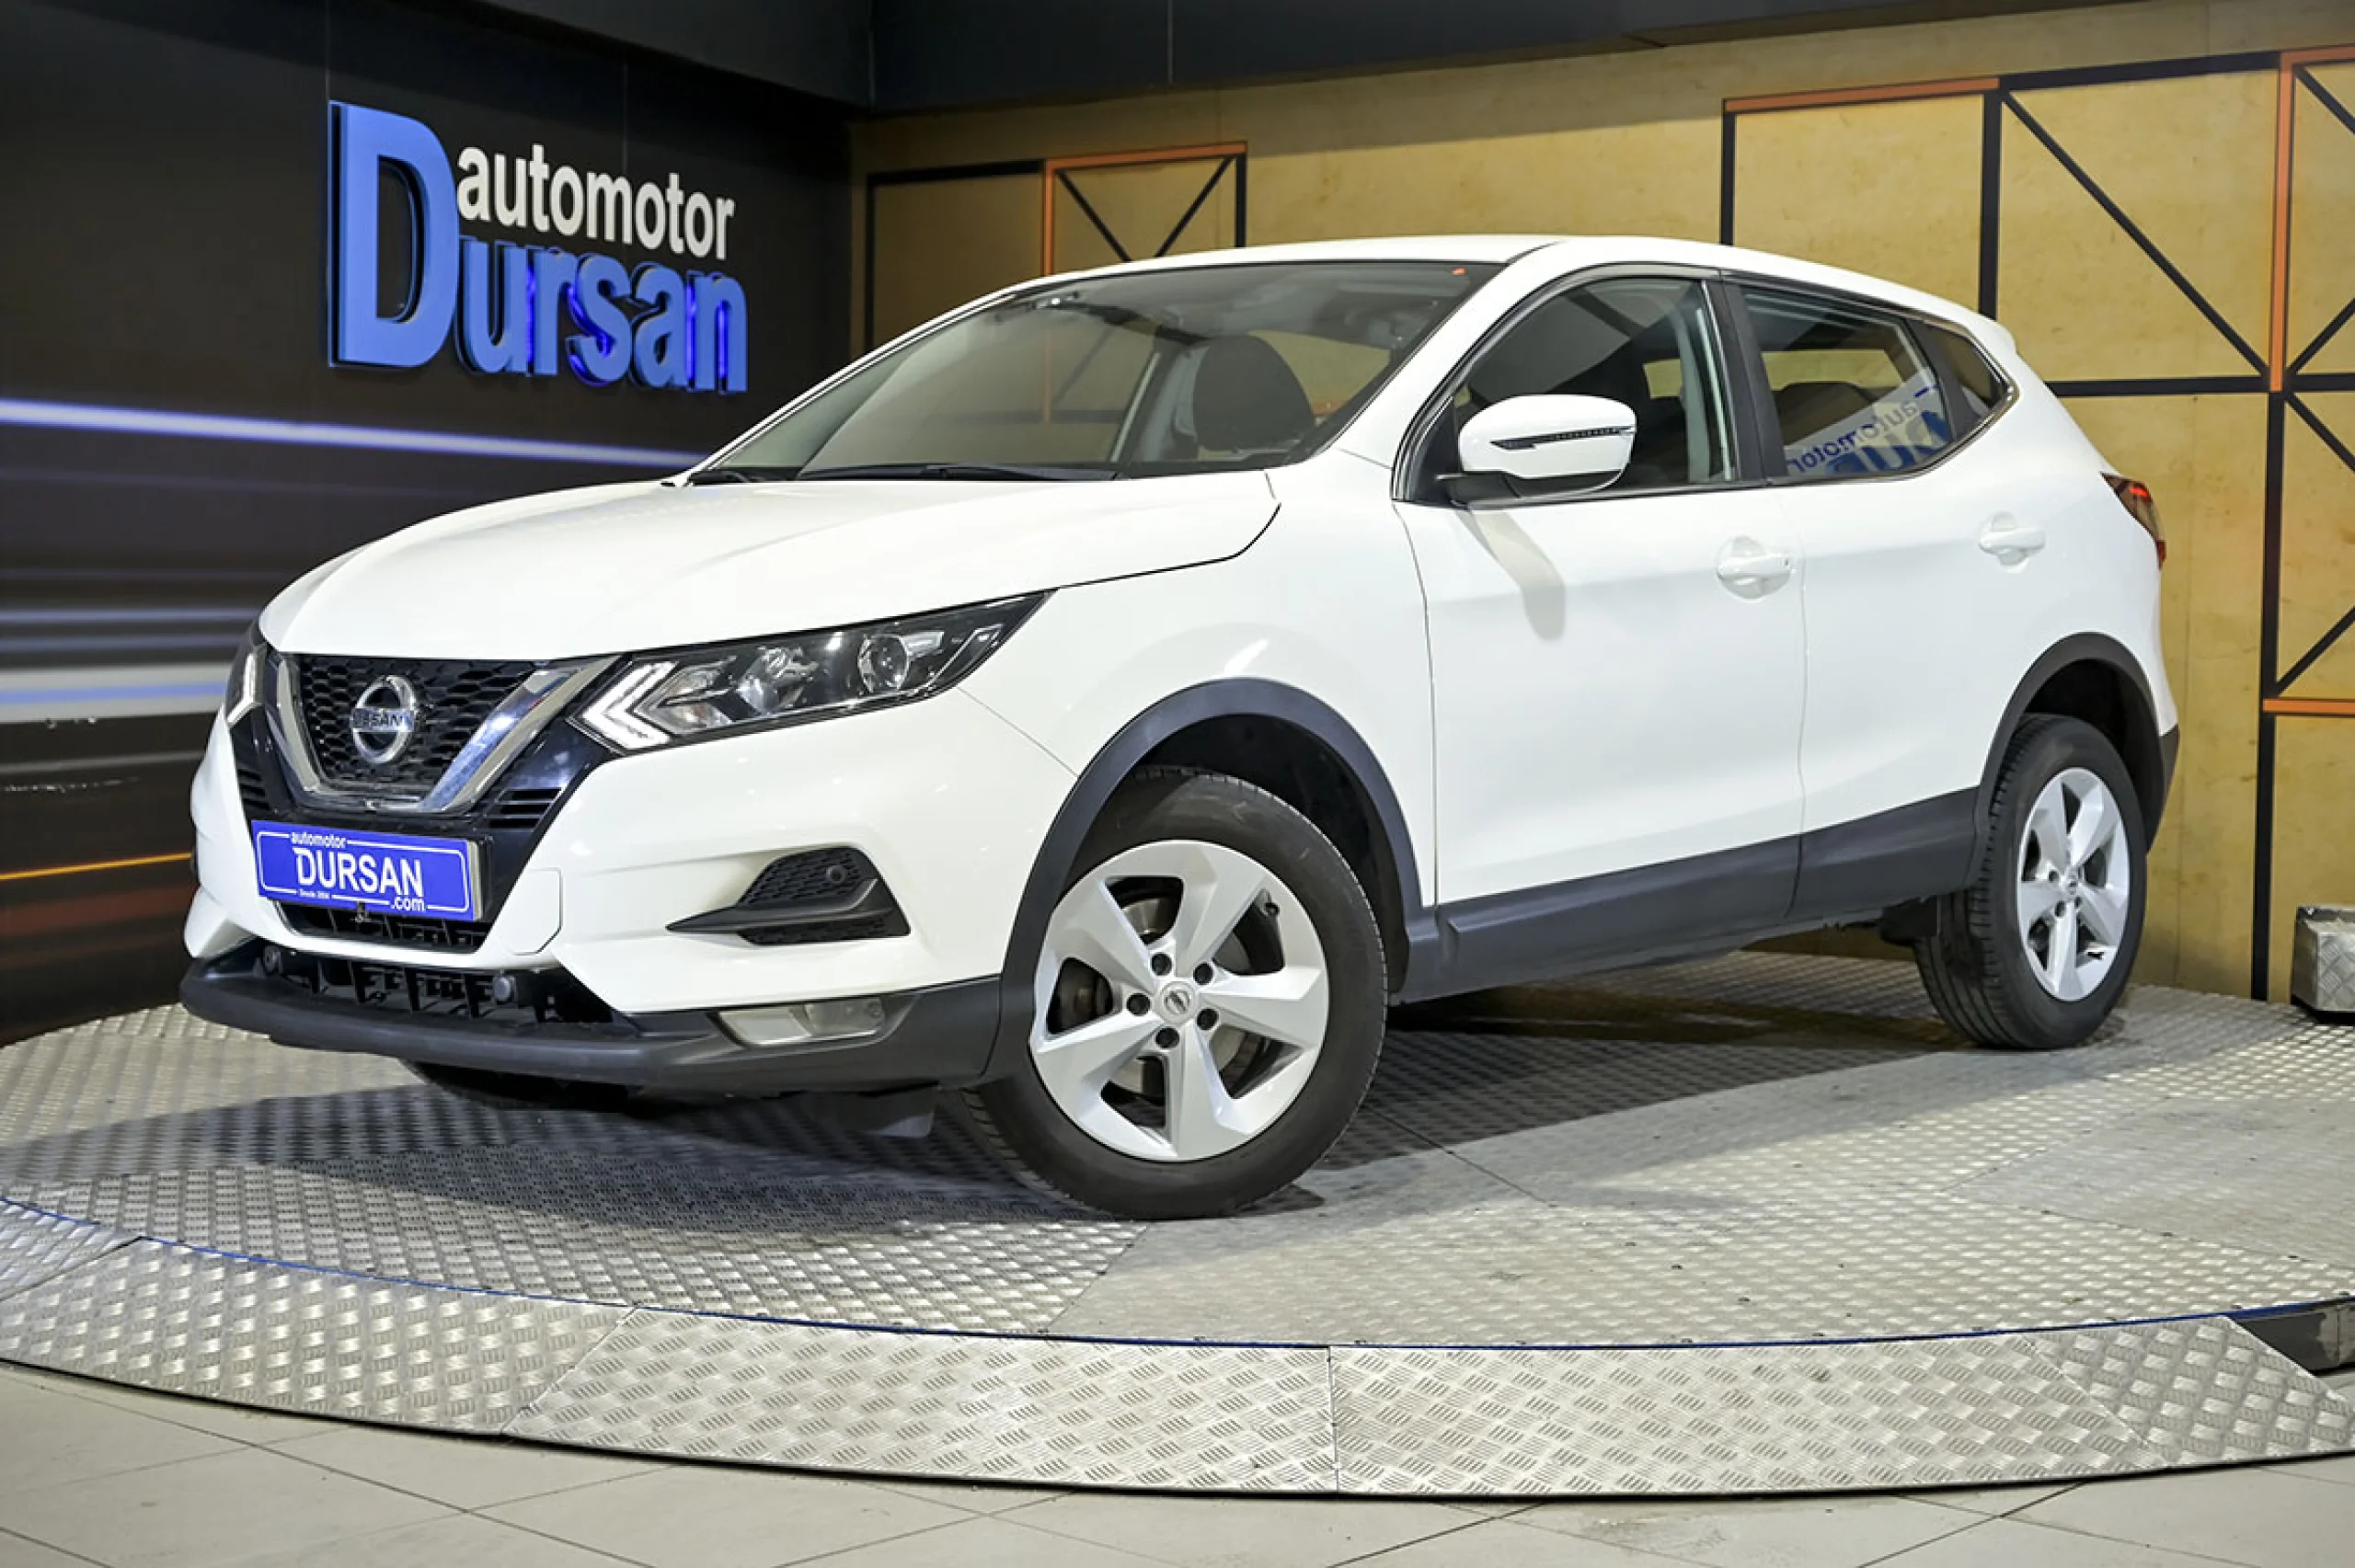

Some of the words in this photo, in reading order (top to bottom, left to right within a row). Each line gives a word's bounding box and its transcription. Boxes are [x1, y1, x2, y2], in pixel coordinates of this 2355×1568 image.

[458, 143, 735, 259] automotor
[328, 99, 748, 394] Dursan
[291, 832, 347, 848] automotor
[293, 847, 424, 898] DURSAN
